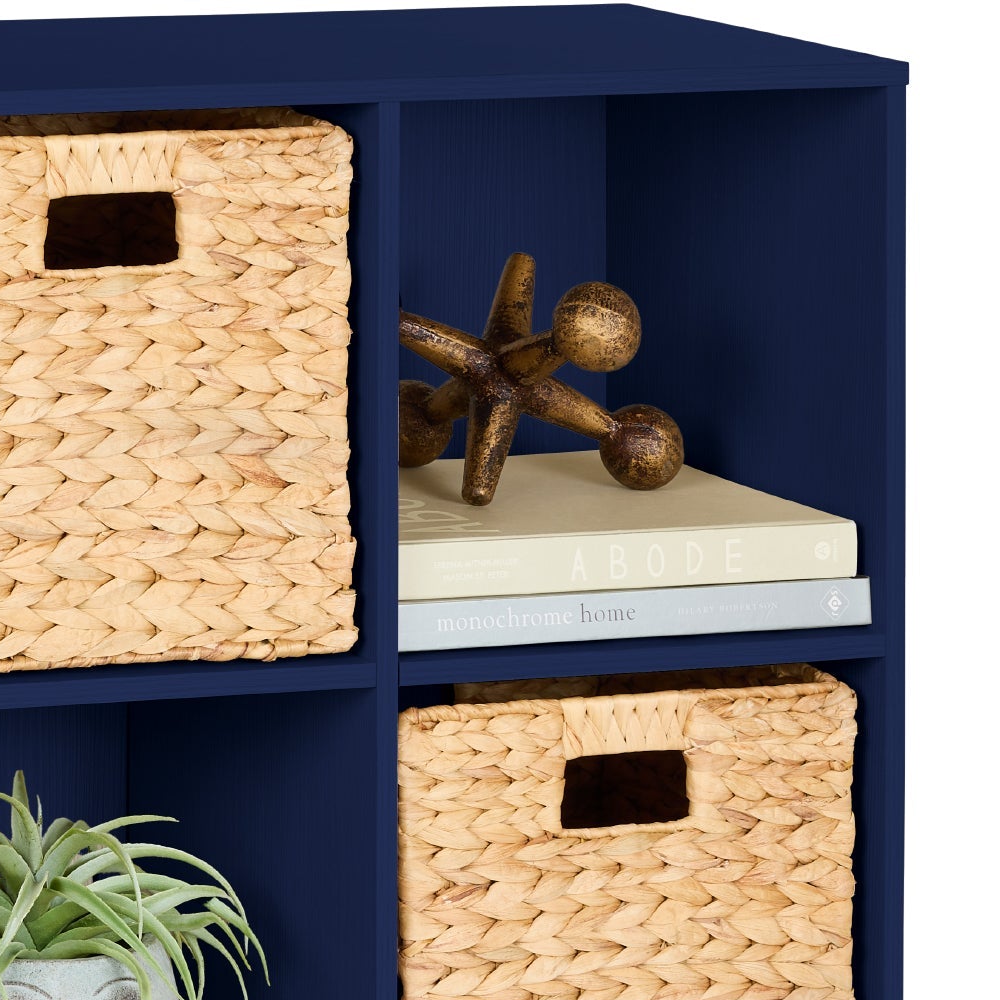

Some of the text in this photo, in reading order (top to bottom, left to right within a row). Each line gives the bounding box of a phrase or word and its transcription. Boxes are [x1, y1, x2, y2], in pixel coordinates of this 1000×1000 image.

[571, 538, 743, 581] ABODE
[437, 602, 636, 632] monochrome home
